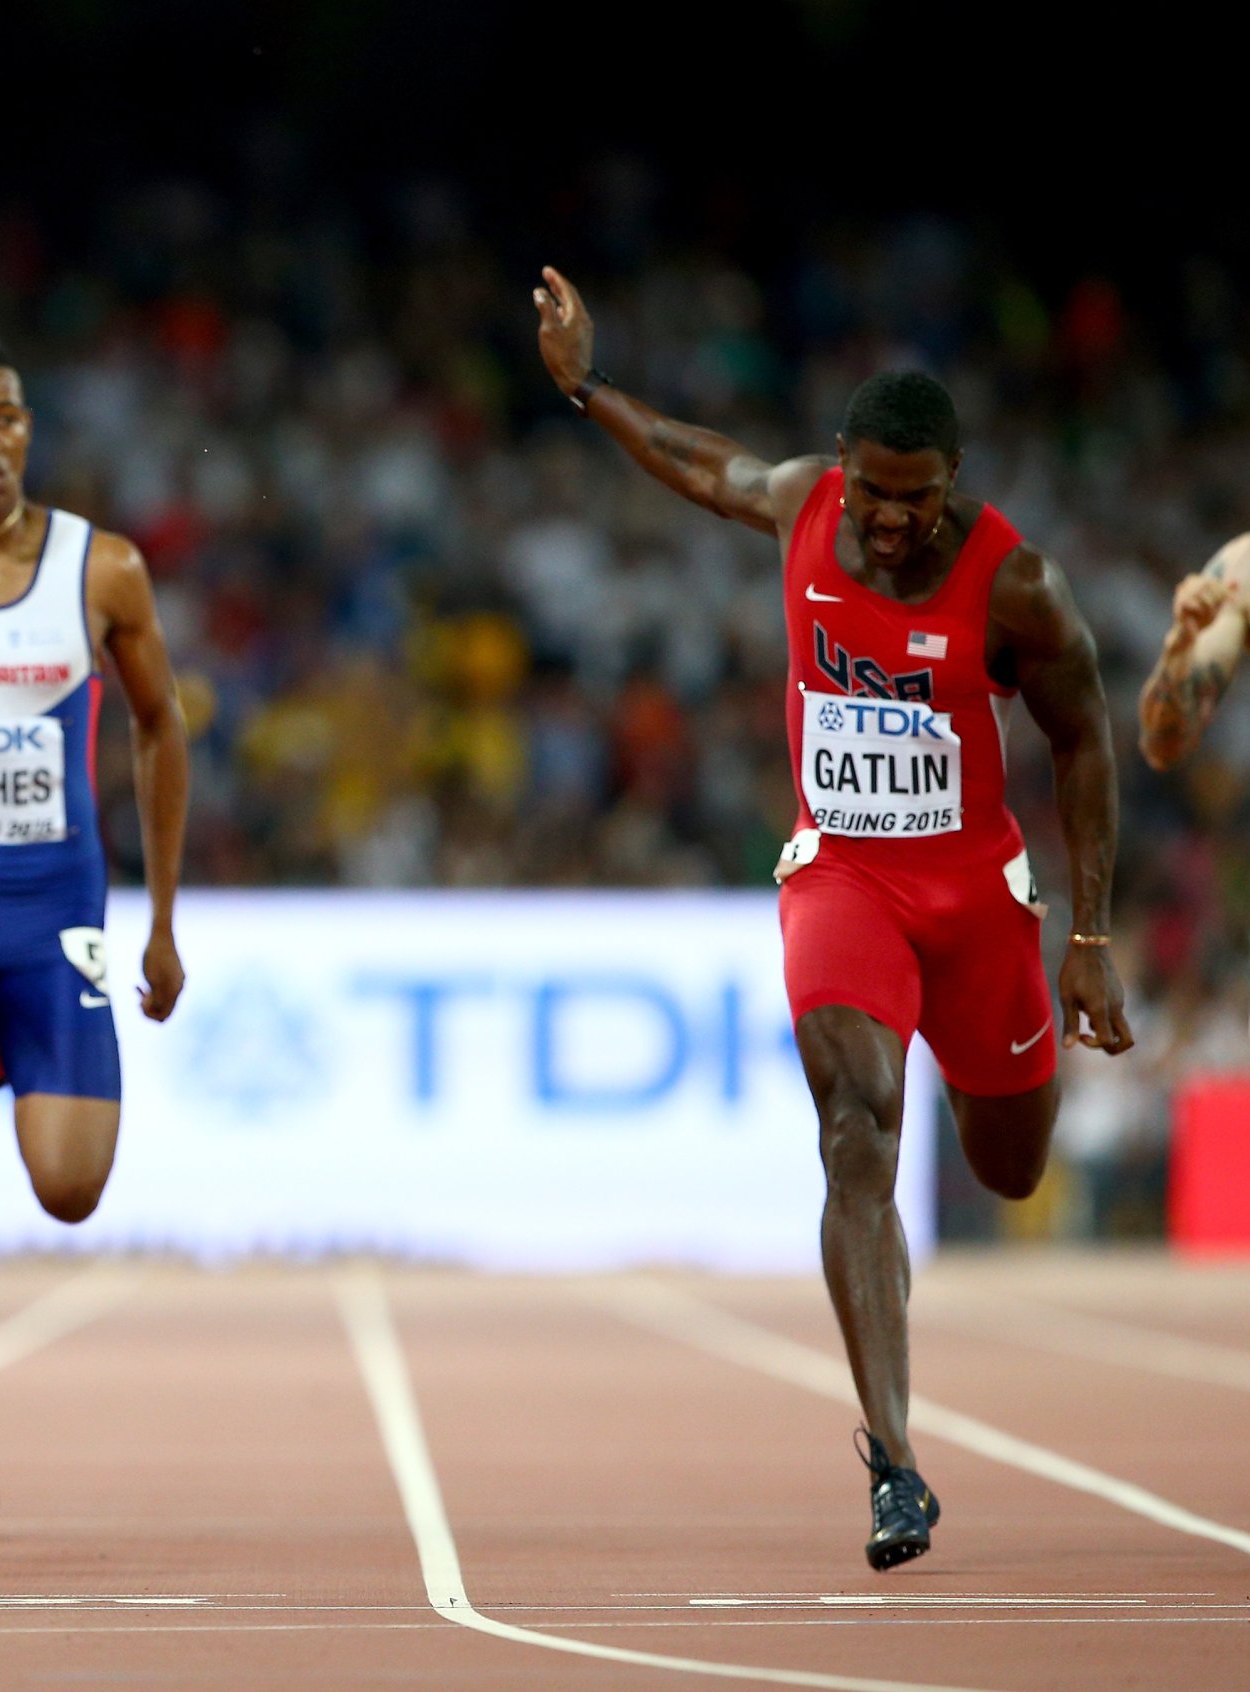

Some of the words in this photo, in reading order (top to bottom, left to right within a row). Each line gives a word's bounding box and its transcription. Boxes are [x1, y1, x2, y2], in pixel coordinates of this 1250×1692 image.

[813, 619, 933, 703] USA
[845, 704, 943, 739] TDK
[814, 748, 948, 795] GATLIN
[814, 808, 897, 832] BEIJING
[902, 807, 953, 832] 2015
